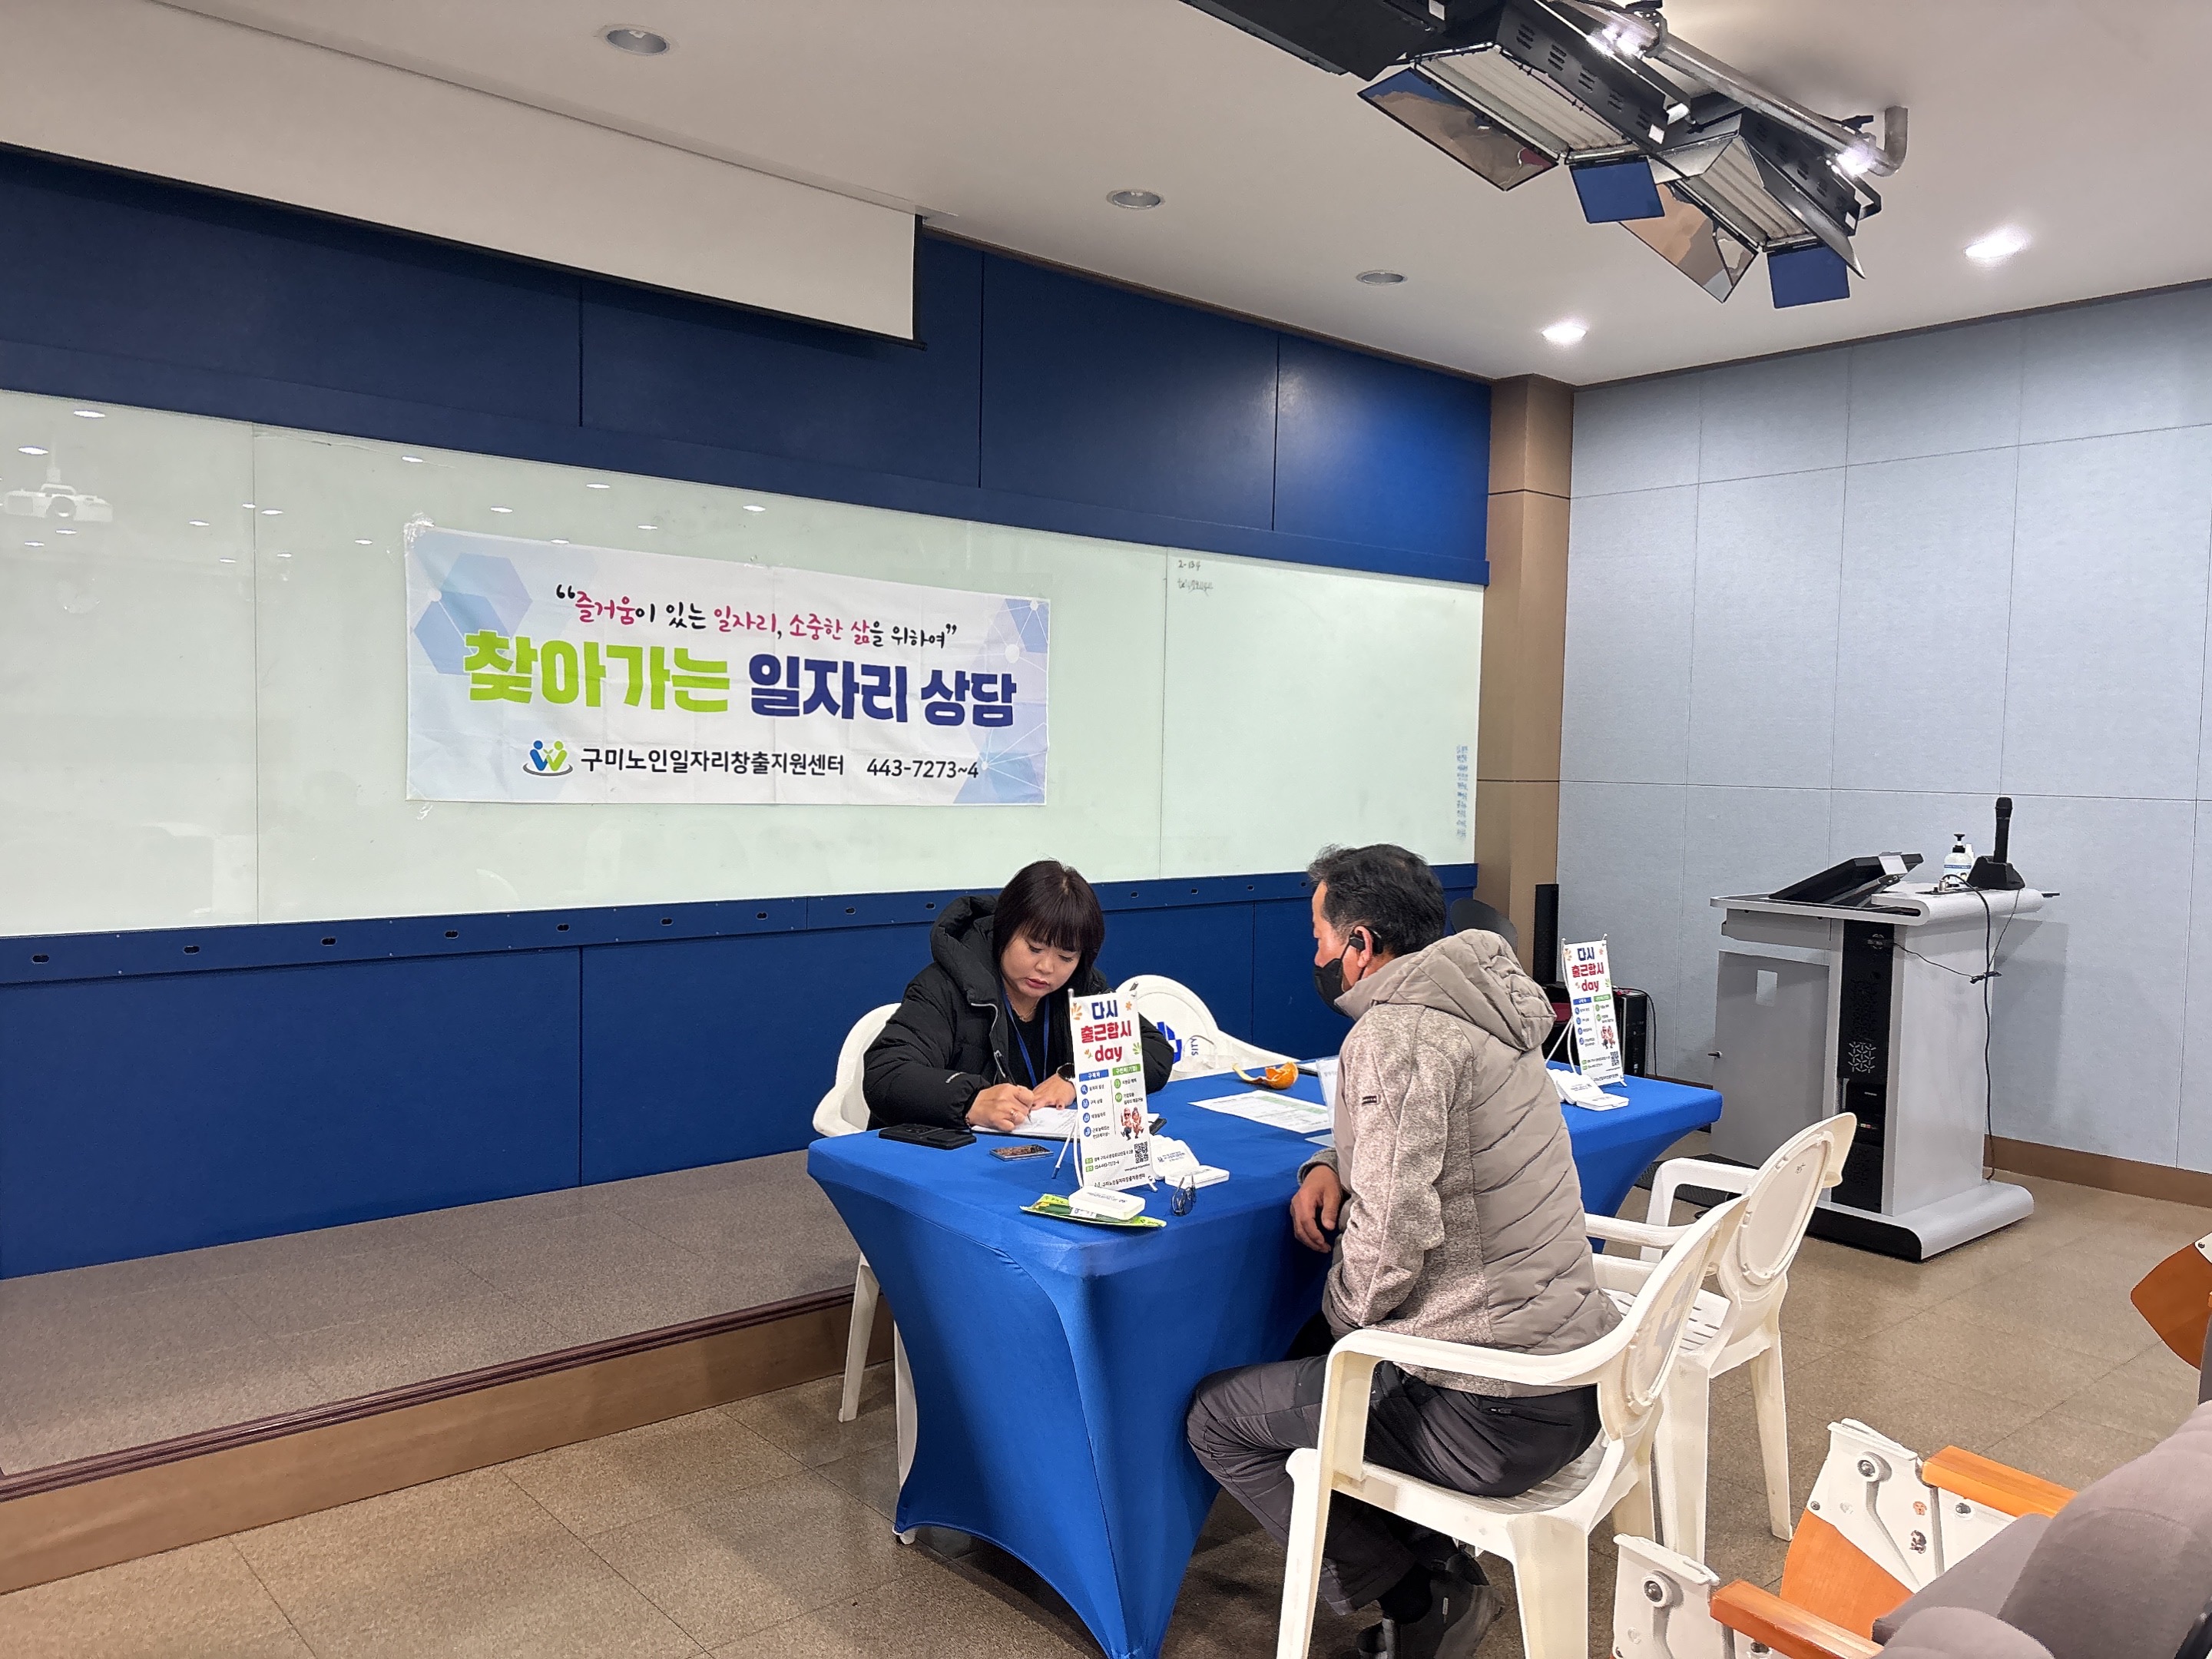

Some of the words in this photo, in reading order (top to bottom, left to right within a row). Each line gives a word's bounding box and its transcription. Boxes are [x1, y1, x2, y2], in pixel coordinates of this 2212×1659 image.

[665, 601, 707, 630] 있는
[714, 605, 783, 640] 일자리,
[789, 613, 843, 641] 소중한
[850, 619, 884, 647] 삶을
[463, 629, 730, 713] 찾아가는
[748, 653, 909, 724] 일자리
[920, 668, 1018, 727] 상담
[580, 746, 845, 777] 구미노인일자리창출지원센터
[866, 757, 979, 780] 443-7273~4
[1577, 946, 1595, 962] 다시
[1571, 962, 1604, 979] 출근합시
[1581, 979, 1599, 992] day
[1091, 999, 1118, 1021] 다시
[1081, 1019, 1132, 1044] 출근합시
[1094, 1045, 1123, 1062] day
